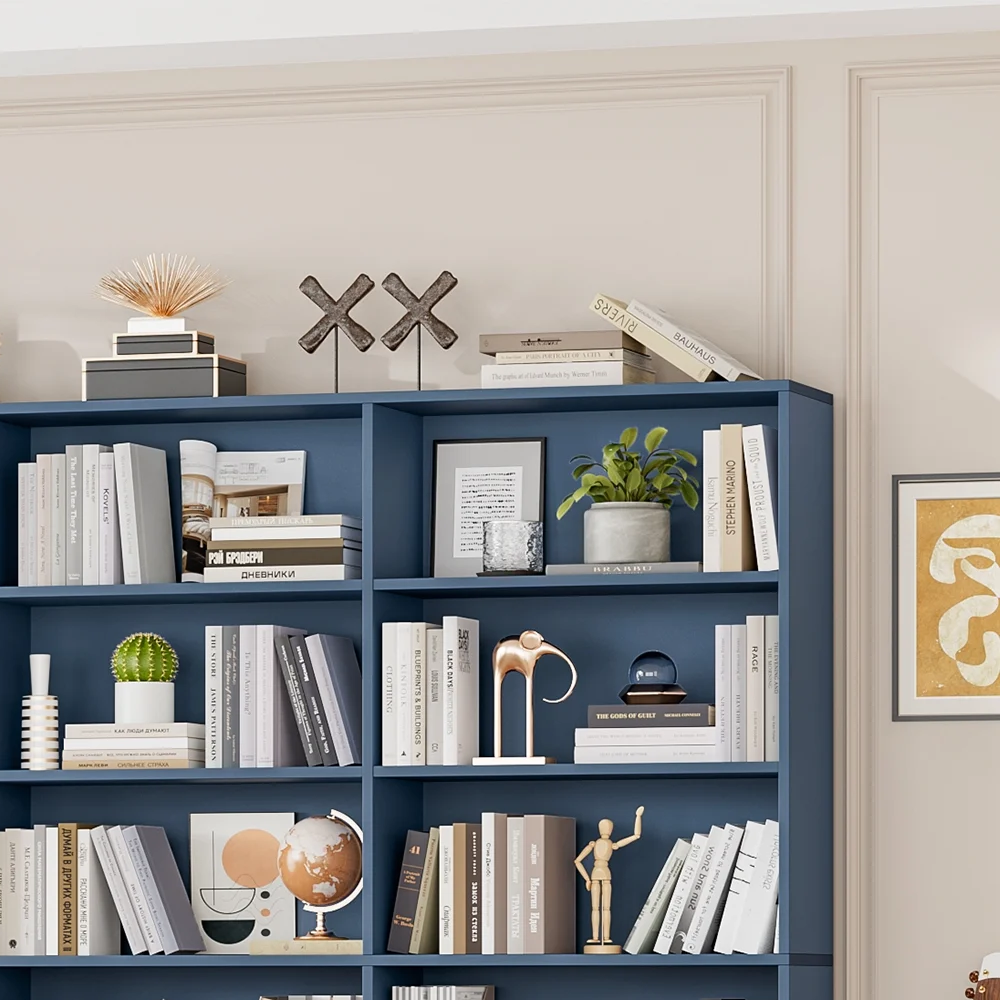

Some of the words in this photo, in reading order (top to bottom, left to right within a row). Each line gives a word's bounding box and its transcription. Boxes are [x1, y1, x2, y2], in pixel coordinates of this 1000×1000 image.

[594, 298, 639, 334] RIVERS
[673, 332, 717, 365] BAUHAUS
[748, 438, 760, 464] SQUID
[726, 459, 736, 494] MARINO
[755, 480, 766, 511] PROUST
[726, 495, 736, 536] STEPHEN
[208, 550, 224, 565] РЭЙ
[225, 551, 264, 565] БРЭДБЕРИ
[241, 570, 296, 579] ДНЕВНИКИ
[61, 828, 74, 858] ДУМАЙ
[62, 867, 72, 899] ДРУГИХ
[528, 878, 540, 909] Мартин
[63, 900, 72, 945] ФОРМАТАХ
[471, 906, 478, 917] из
[530, 912, 540, 933] Иден
